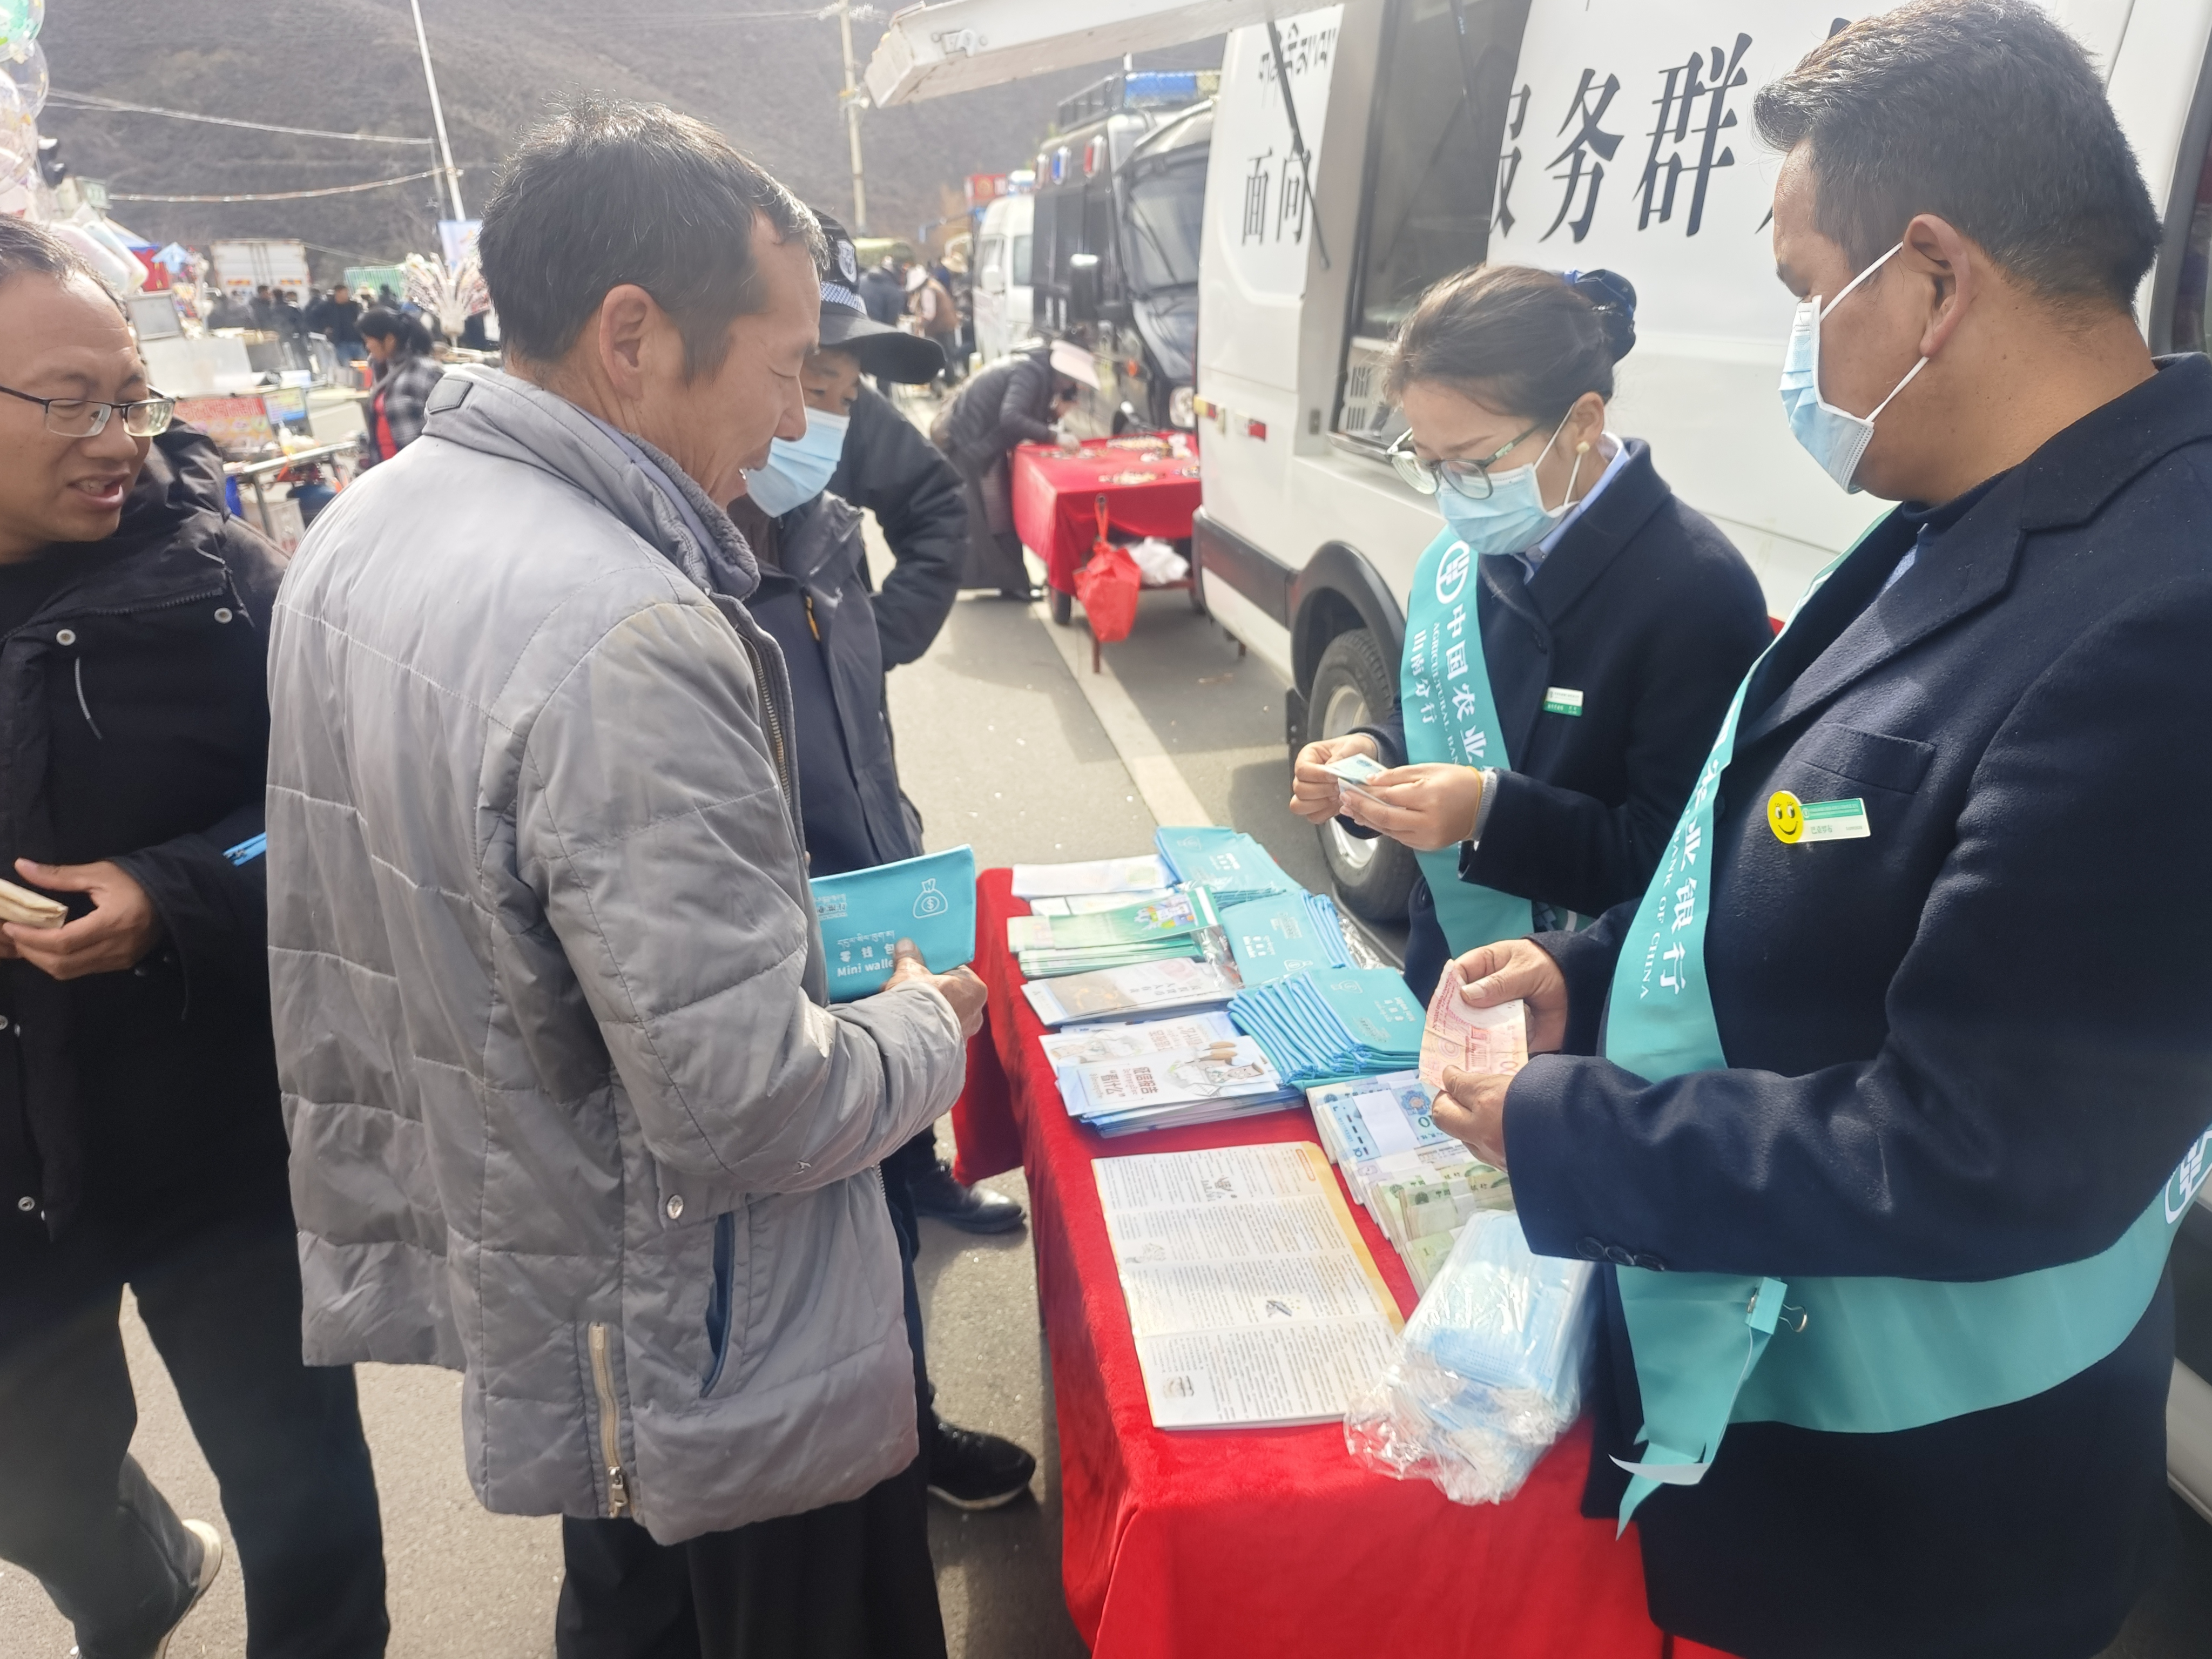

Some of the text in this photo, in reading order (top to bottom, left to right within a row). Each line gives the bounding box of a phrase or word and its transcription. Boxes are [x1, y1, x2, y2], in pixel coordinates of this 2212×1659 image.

[1242, 146, 1311, 244] 面向
[1411, 629, 1438, 724] 山南分行
[1431, 622, 1459, 764] AGRICULTURAL BAN
[1445, 603, 1494, 771] 中国农业
[1657, 896, 1667, 923] OF
[838, 958, 894, 977] Mini walle
[1641, 932, 1661, 999] CHINA
[1133, 1067, 1158, 1094] 征信报告
